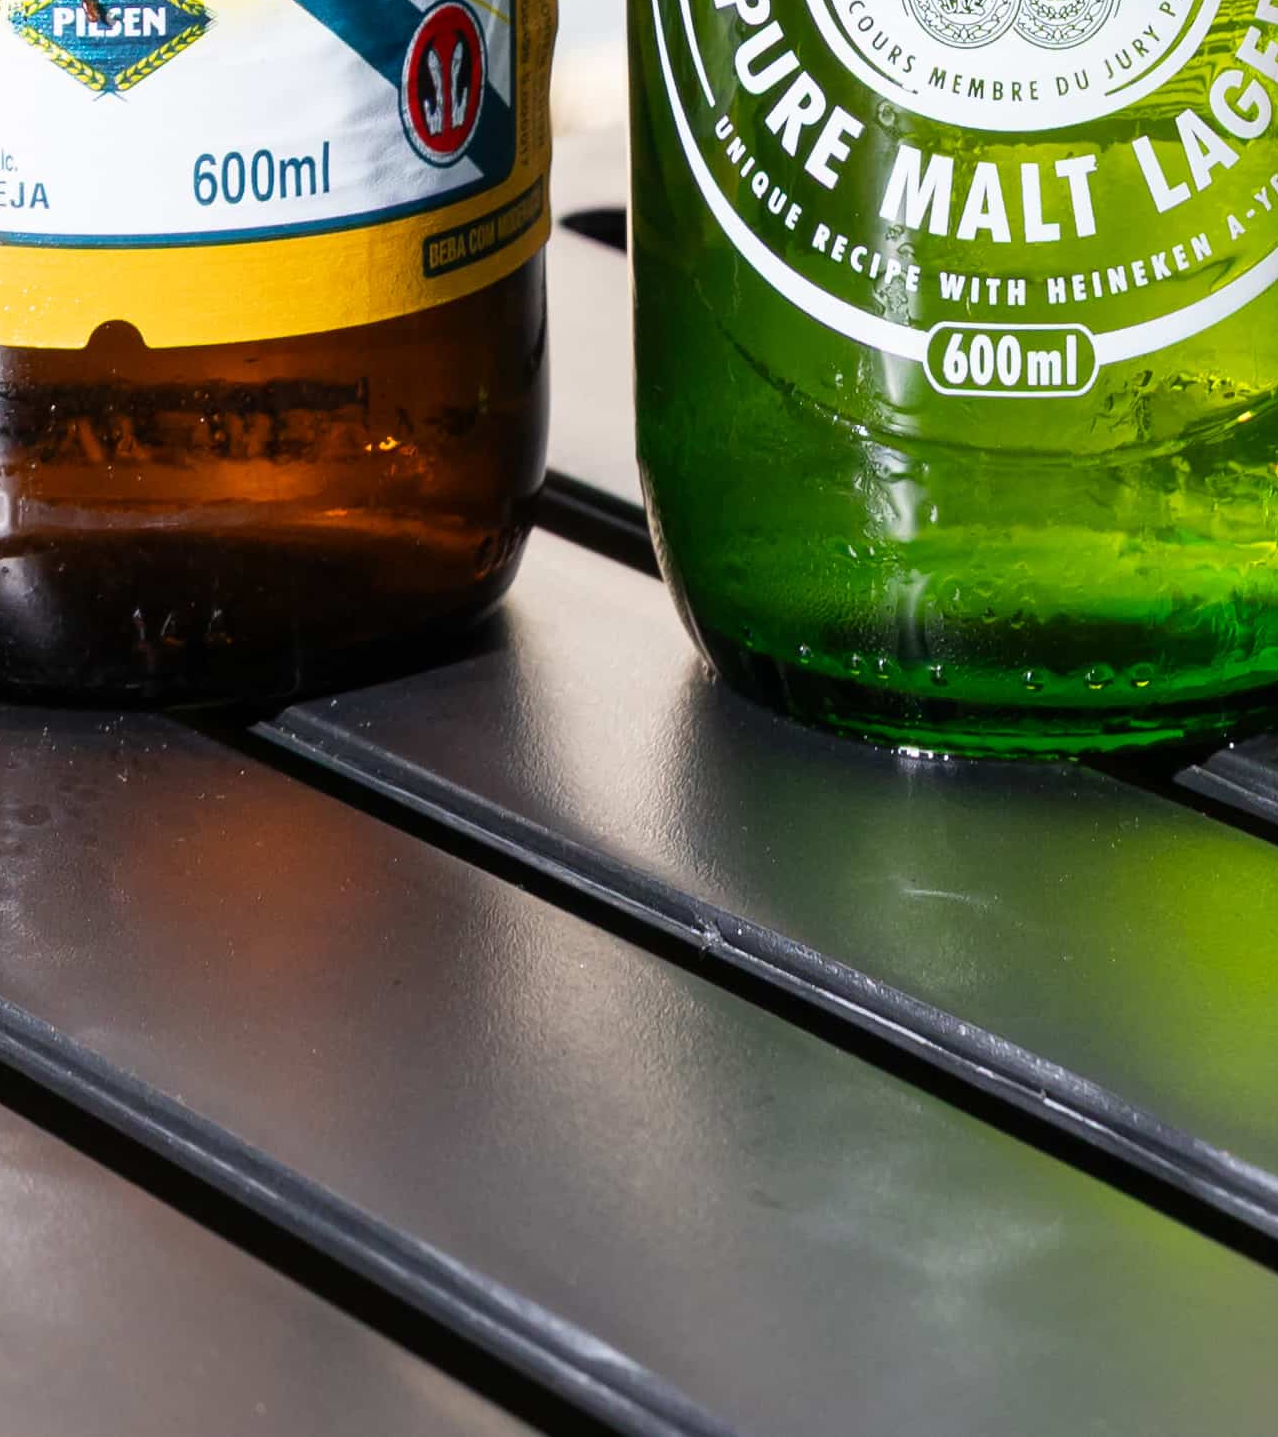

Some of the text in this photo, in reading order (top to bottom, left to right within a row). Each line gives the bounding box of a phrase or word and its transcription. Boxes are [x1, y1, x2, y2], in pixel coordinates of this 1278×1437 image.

[52, 4, 168, 39] PILSEN
[927, 66, 1041, 104] MEMBRE
[1054, 71, 1091, 102] DU
[1103, 24, 1162, 83] JURY
[191, 142, 333, 207] 600ml
[878, 152, 1099, 245] MALT
[714, 116, 803, 232] UNIQUE
[810, 223, 923, 296] RECIPE
[939, 271, 1027, 307] WITH
[1046, 230, 1215, 306] HEINEKEN
[429, 230, 467, 270] BEBA
[941, 332, 1079, 388] 600ml
